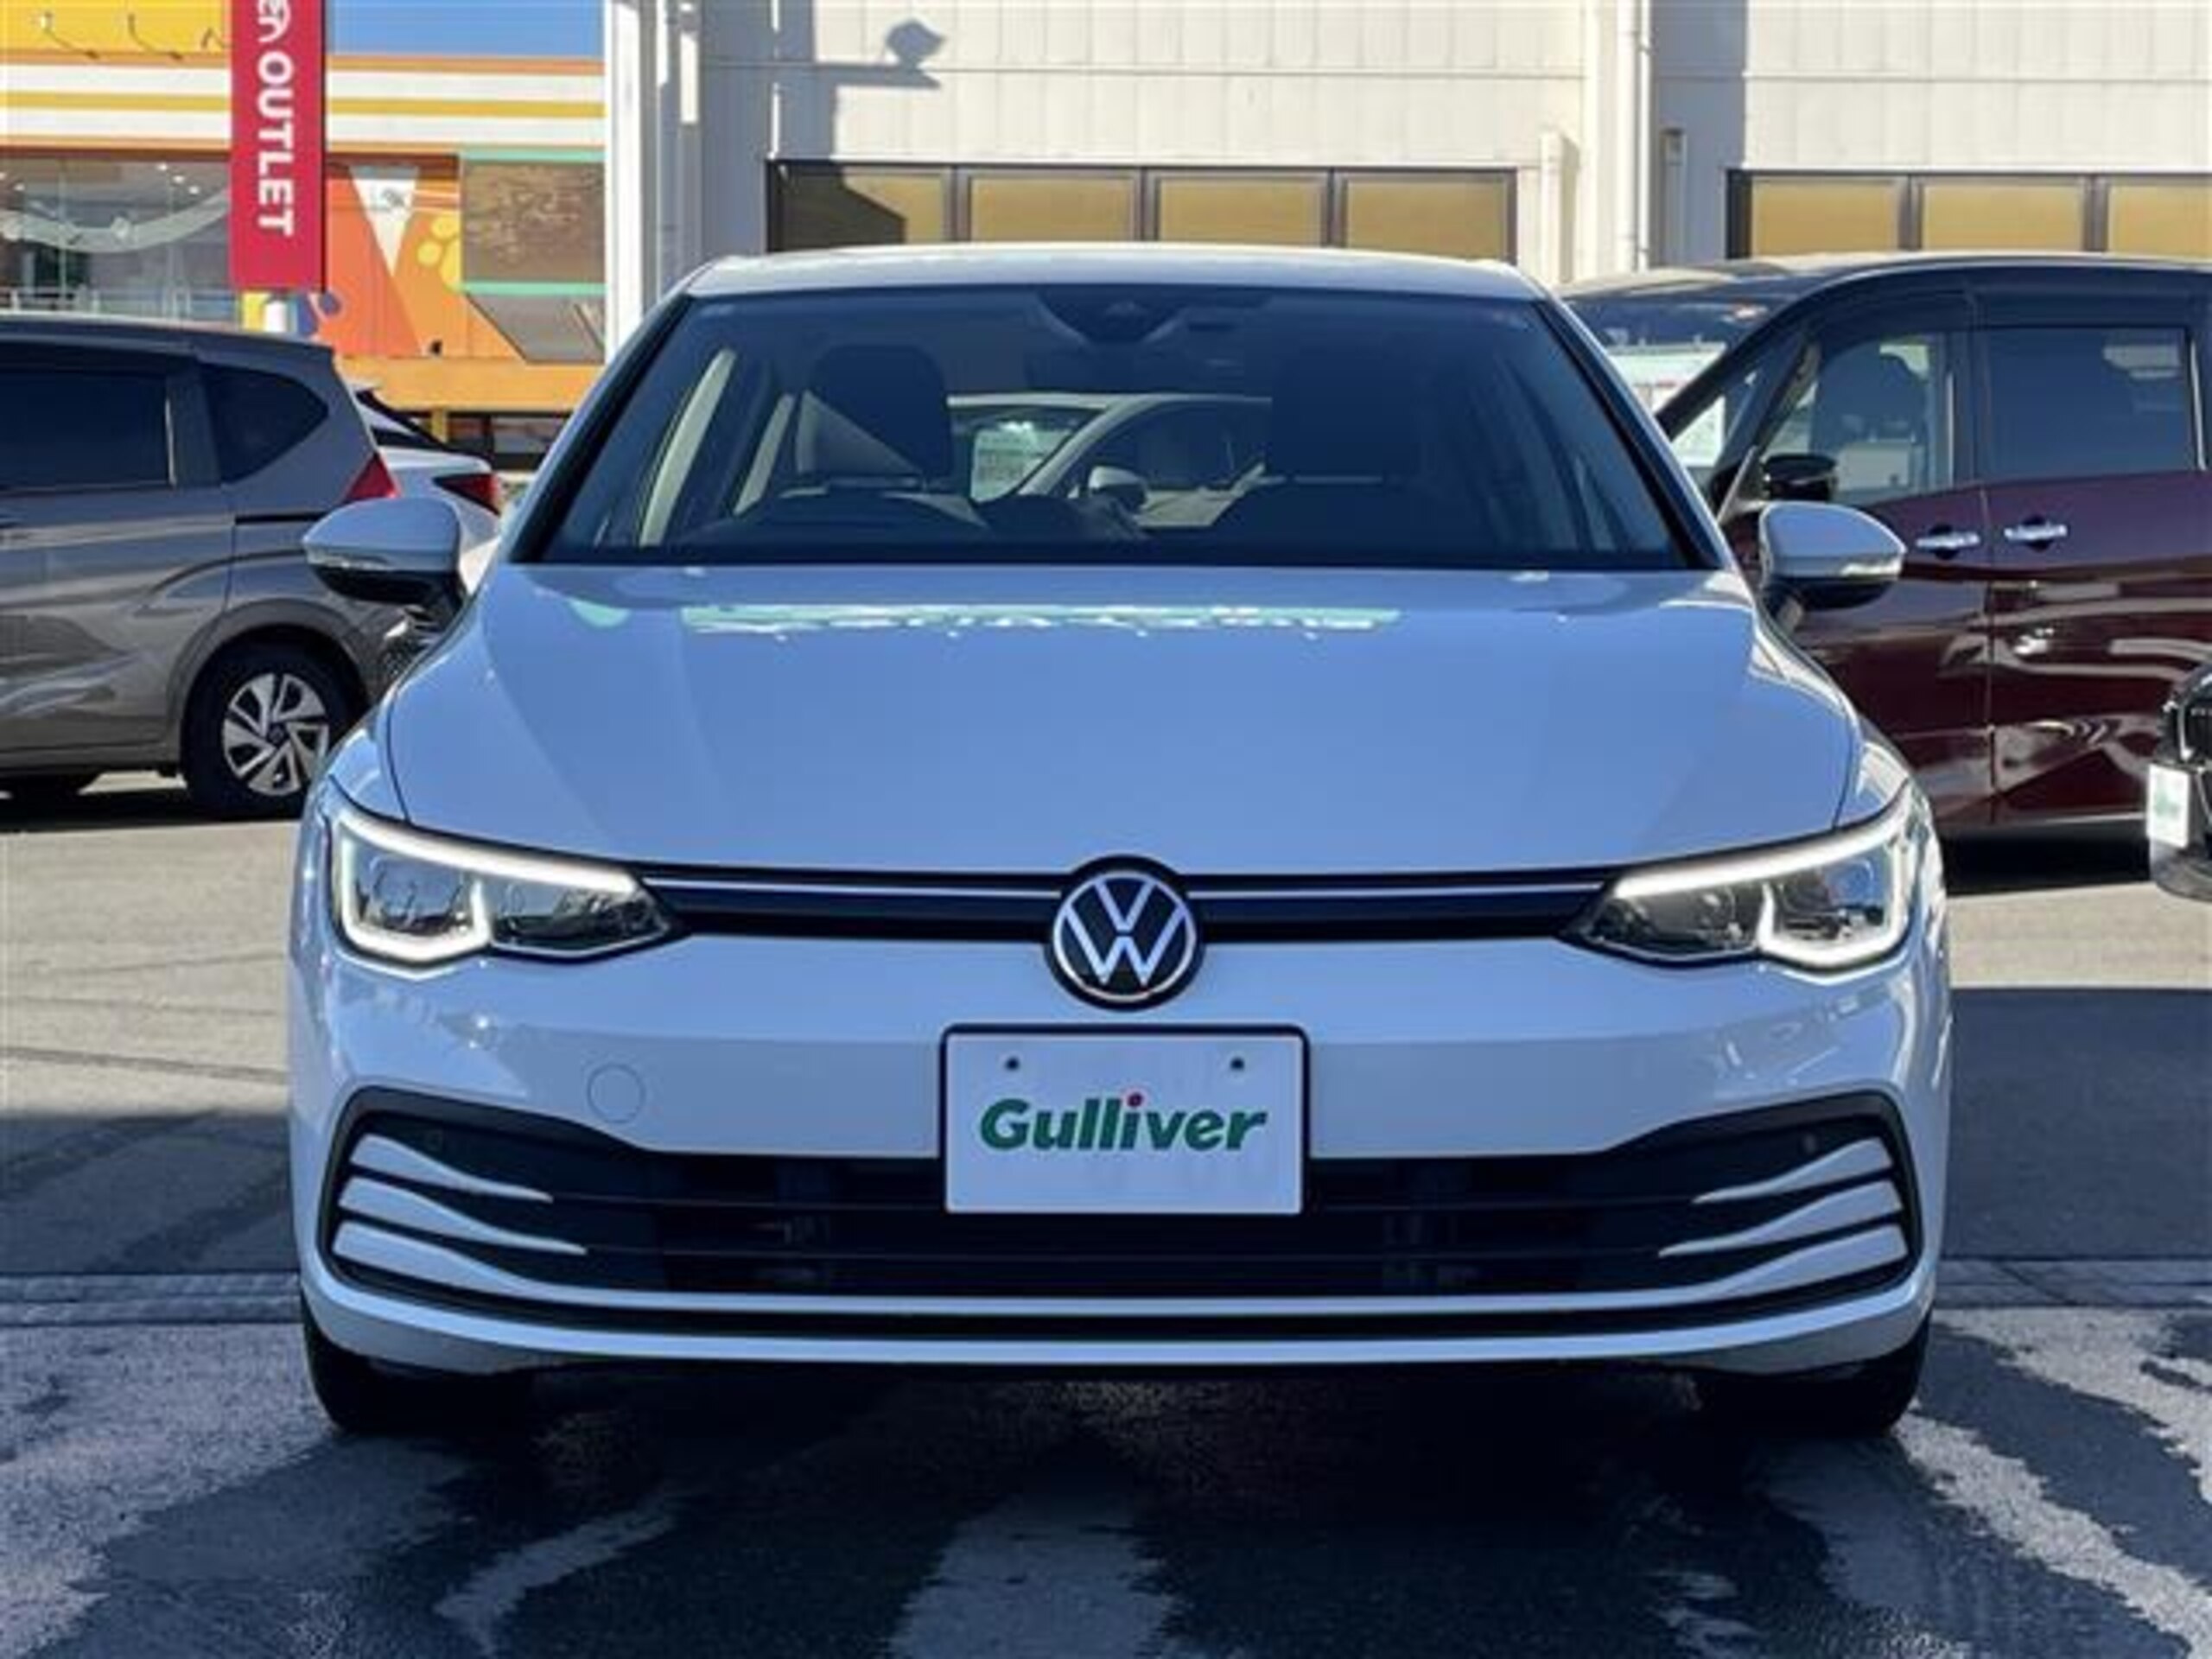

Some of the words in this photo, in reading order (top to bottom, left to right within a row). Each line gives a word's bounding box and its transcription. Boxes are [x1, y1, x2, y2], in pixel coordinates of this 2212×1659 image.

[258, 50, 294, 237] OUTLET
[1059, 876, 1189, 987] VW
[980, 1091, 1268, 1152] Gulliver
